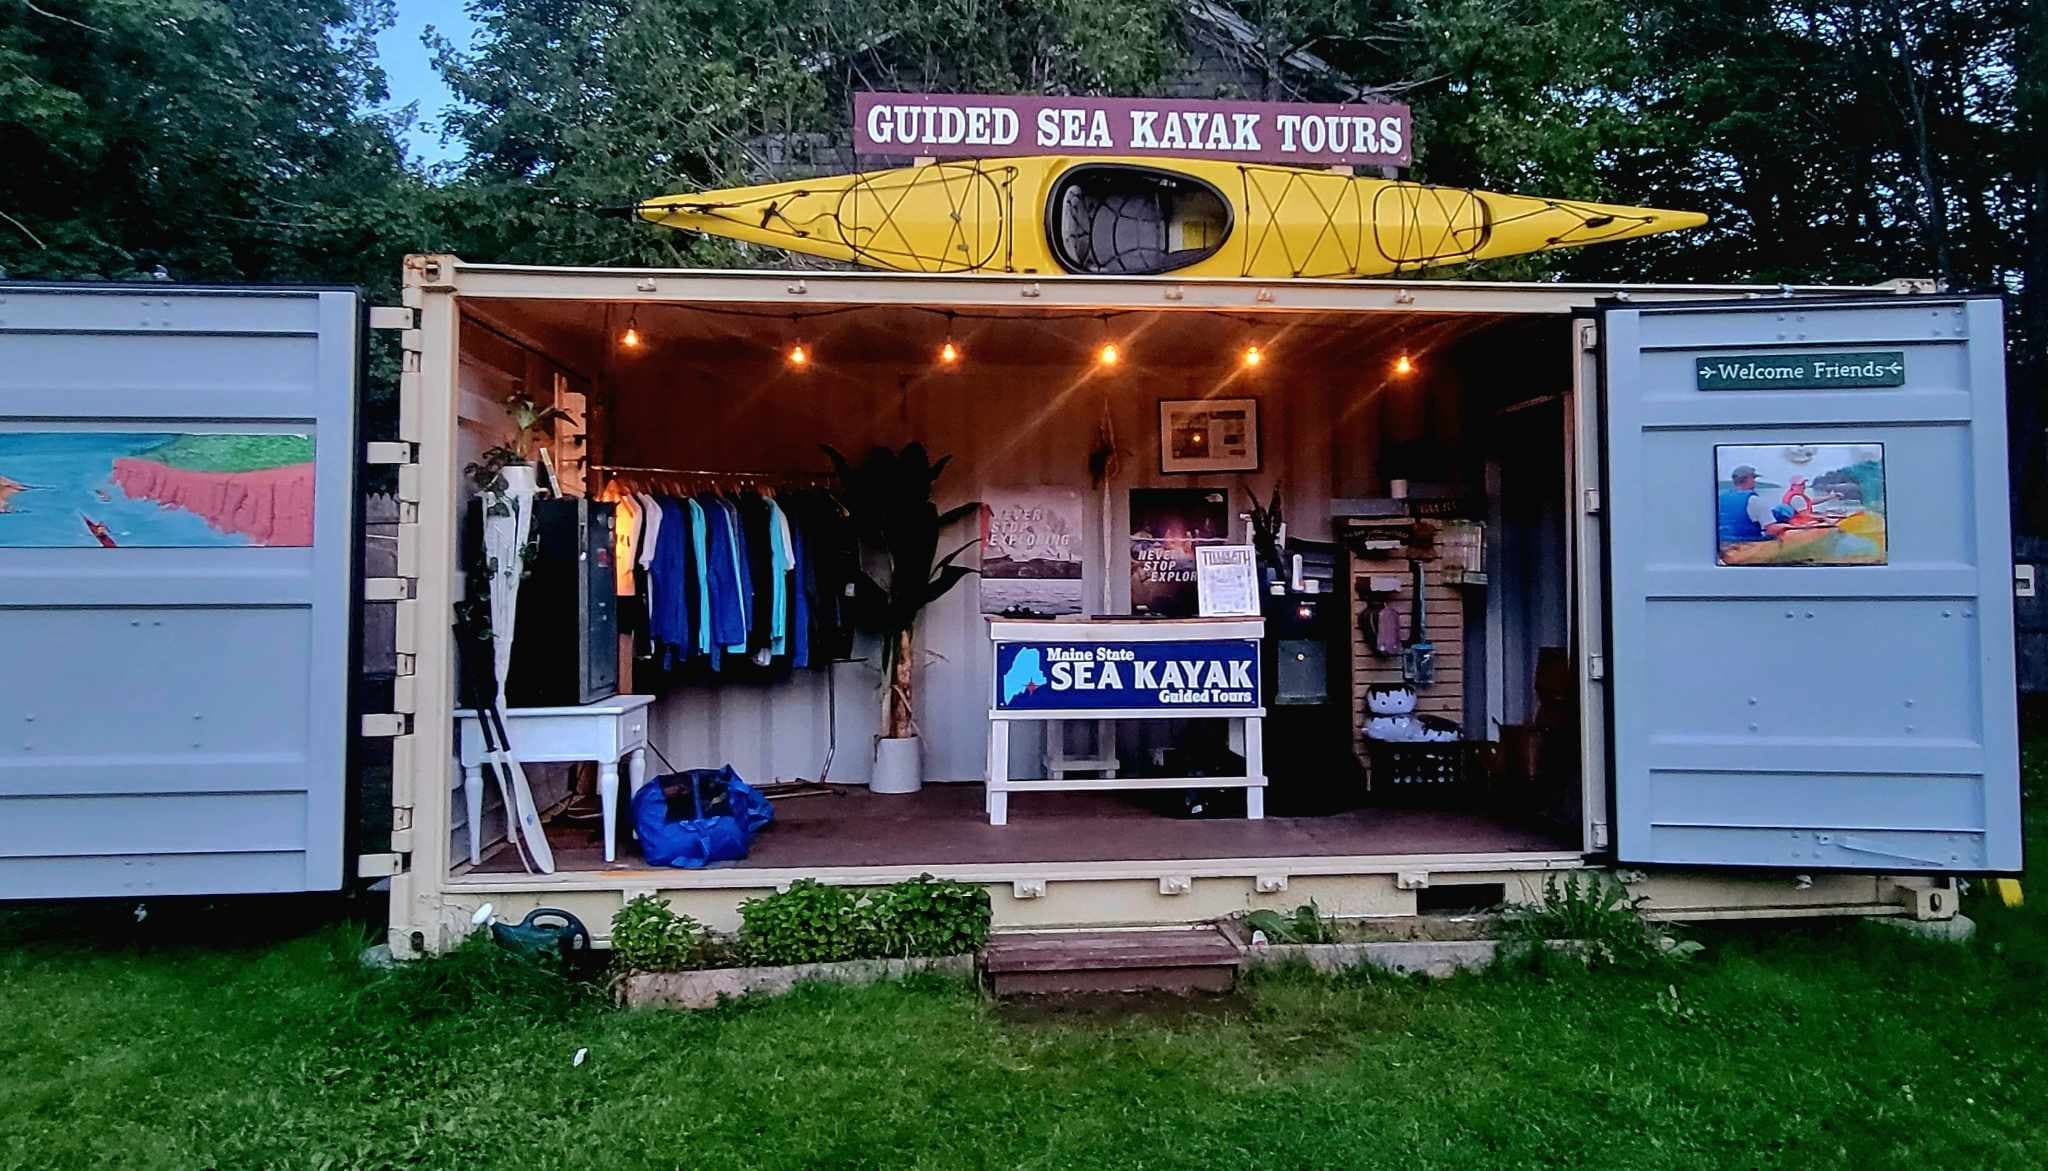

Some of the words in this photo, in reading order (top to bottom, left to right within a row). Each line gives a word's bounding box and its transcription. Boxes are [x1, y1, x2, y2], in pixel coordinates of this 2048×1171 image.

[867, 105, 1020, 146] GUIDED
[1037, 108, 1113, 148] SEA
[1130, 110, 1261, 152] KAYAK
[1277, 114, 1402, 155] TOURS
[1718, 362, 1804, 380] Welcome
[1813, 361, 1884, 378] Friends
[991, 521, 1030, 533] STOP
[1143, 560, 1177, 571] STOP
[1047, 648, 1093, 661] Maine
[1096, 648, 1134, 661] State
[1050, 661, 1123, 691] SEA
[1134, 660, 1253, 690] KAYAK
[1159, 689, 1209, 703] Guided
[1211, 689, 1252, 703] Tours
